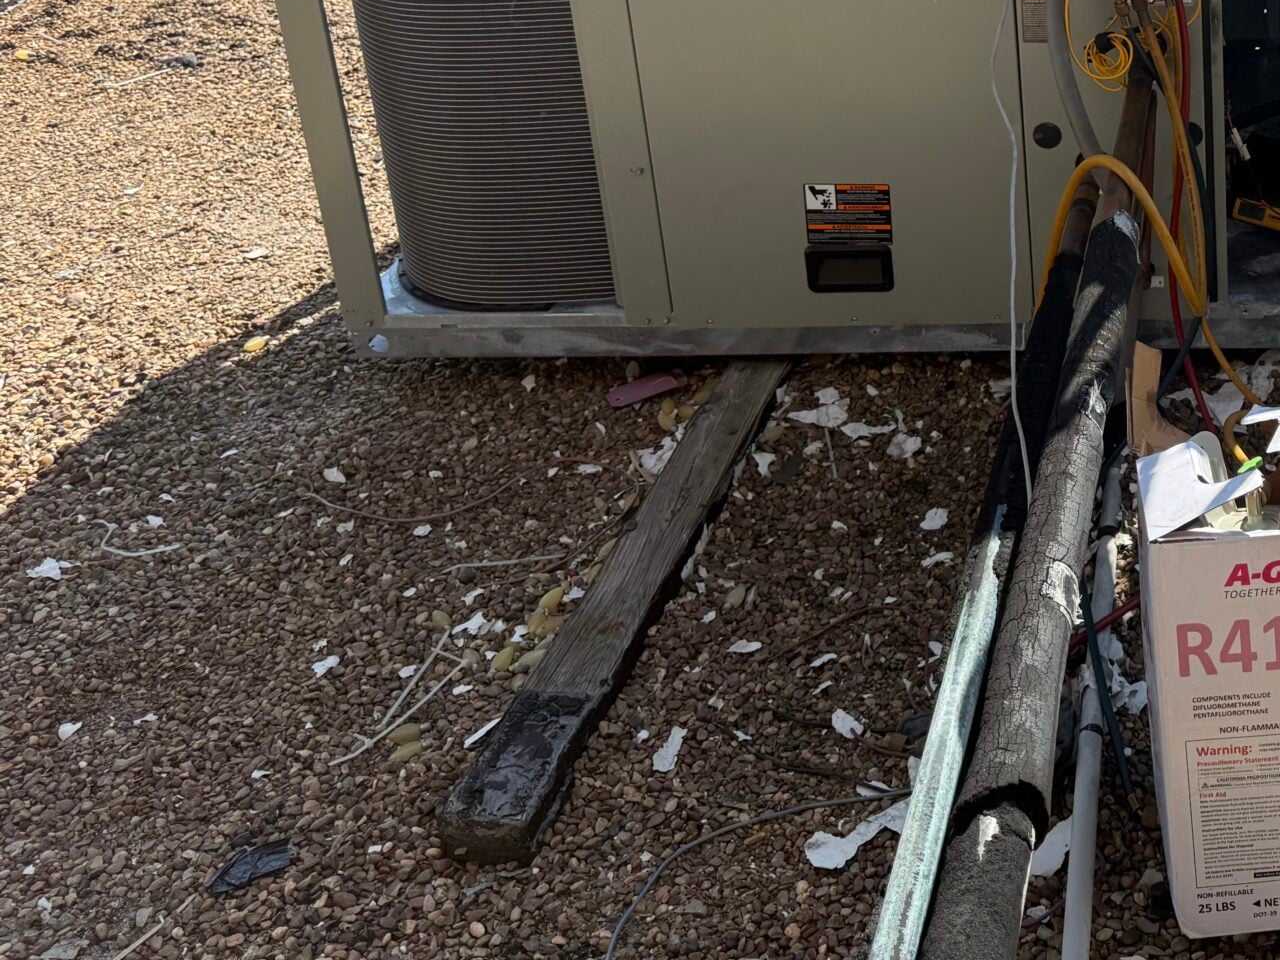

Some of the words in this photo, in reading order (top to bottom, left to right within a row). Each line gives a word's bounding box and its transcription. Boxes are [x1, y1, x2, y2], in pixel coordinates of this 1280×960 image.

[1192, 694, 1241, 704] COMPONENTS
[1242, 691, 1271, 700] INCLUDE
[1192, 700, 1261, 711] DIFLUOROMETHANE
[1193, 708, 1270, 720] PENTAFLUOROETHANE
[1196, 744, 1253, 757] Warning:
[1197, 759, 1243, 768] Precautionary
[1244, 756, 1279, 764] Statement
[1197, 888, 1255, 899] NON-REFILLABLE
[1198, 904, 1212, 914] 25
[1215, 901, 1236, 912] LBS
[1253, 910, 1278, 918] DOT-39
